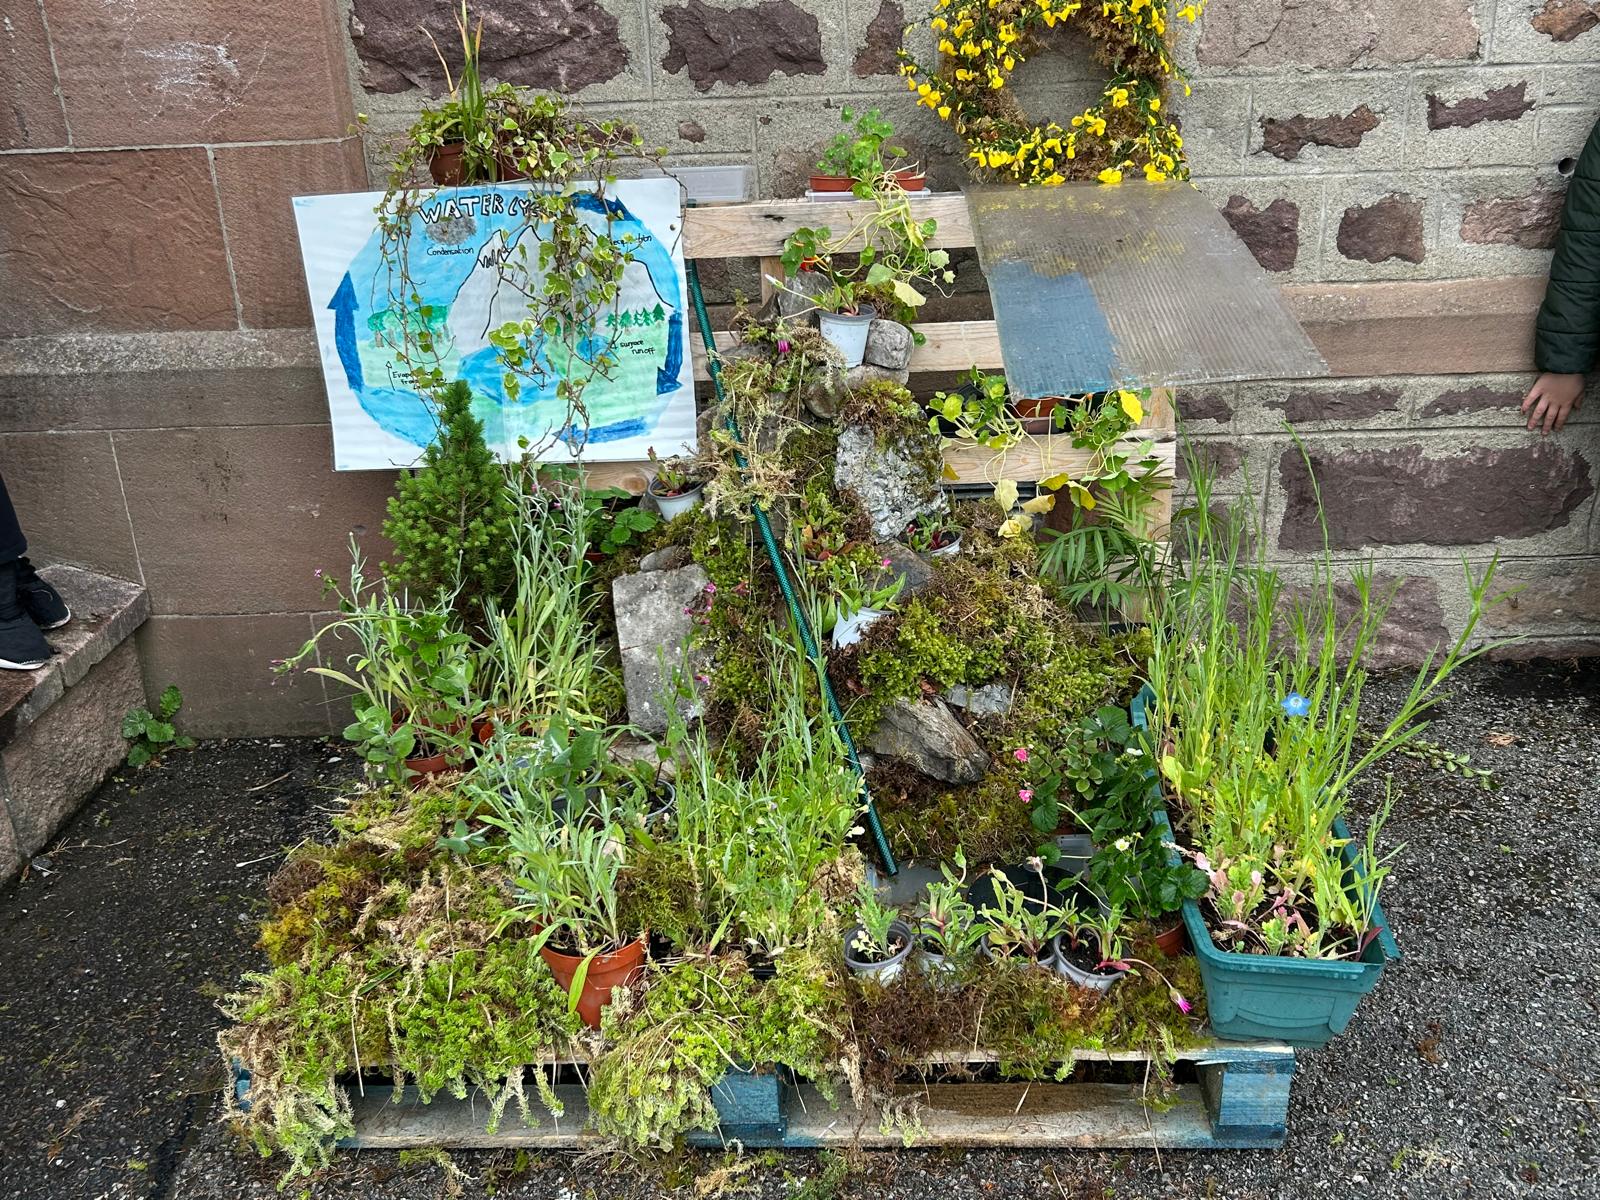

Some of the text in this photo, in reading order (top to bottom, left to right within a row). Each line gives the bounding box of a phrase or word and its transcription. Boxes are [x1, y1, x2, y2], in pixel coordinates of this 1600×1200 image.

[418, 194, 541, 225] WATER CYC
[427, 245, 474, 256] Condensation
